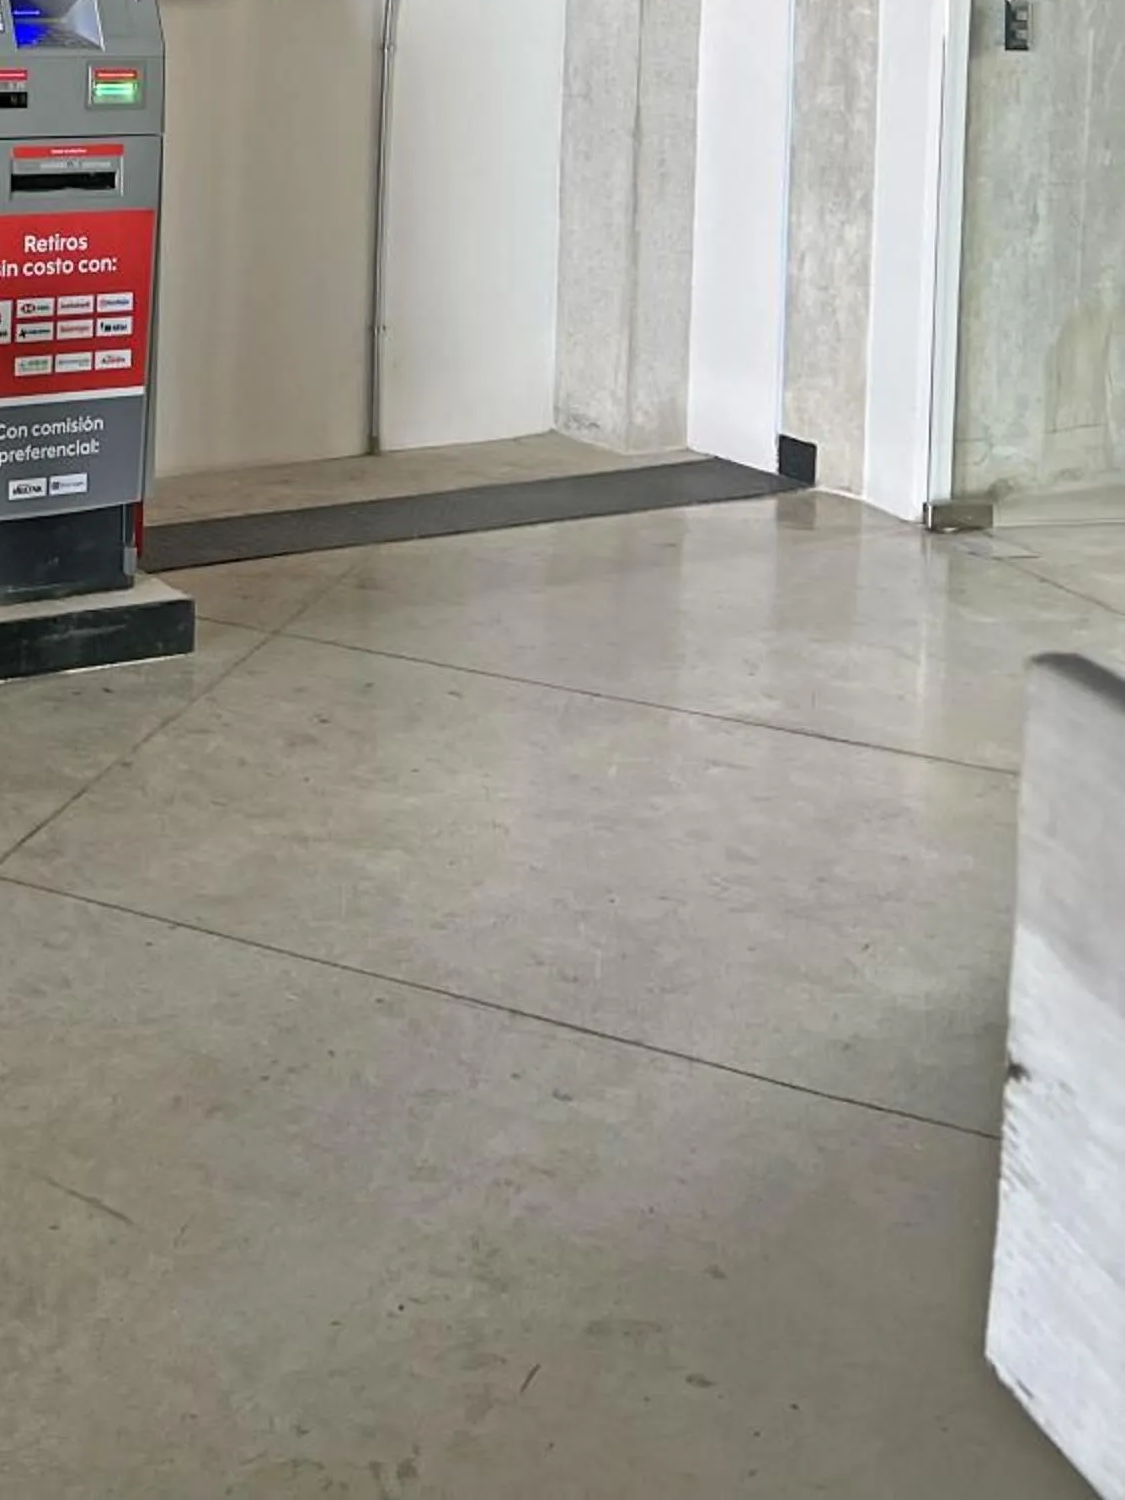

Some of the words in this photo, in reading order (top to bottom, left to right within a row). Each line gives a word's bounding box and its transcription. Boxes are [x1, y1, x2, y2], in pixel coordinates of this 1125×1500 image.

[23, 233, 88, 254] Retiros
[22, 256, 75, 277] costo
[79, 255, 118, 274] con:
[31, 415, 104, 437] comisión
